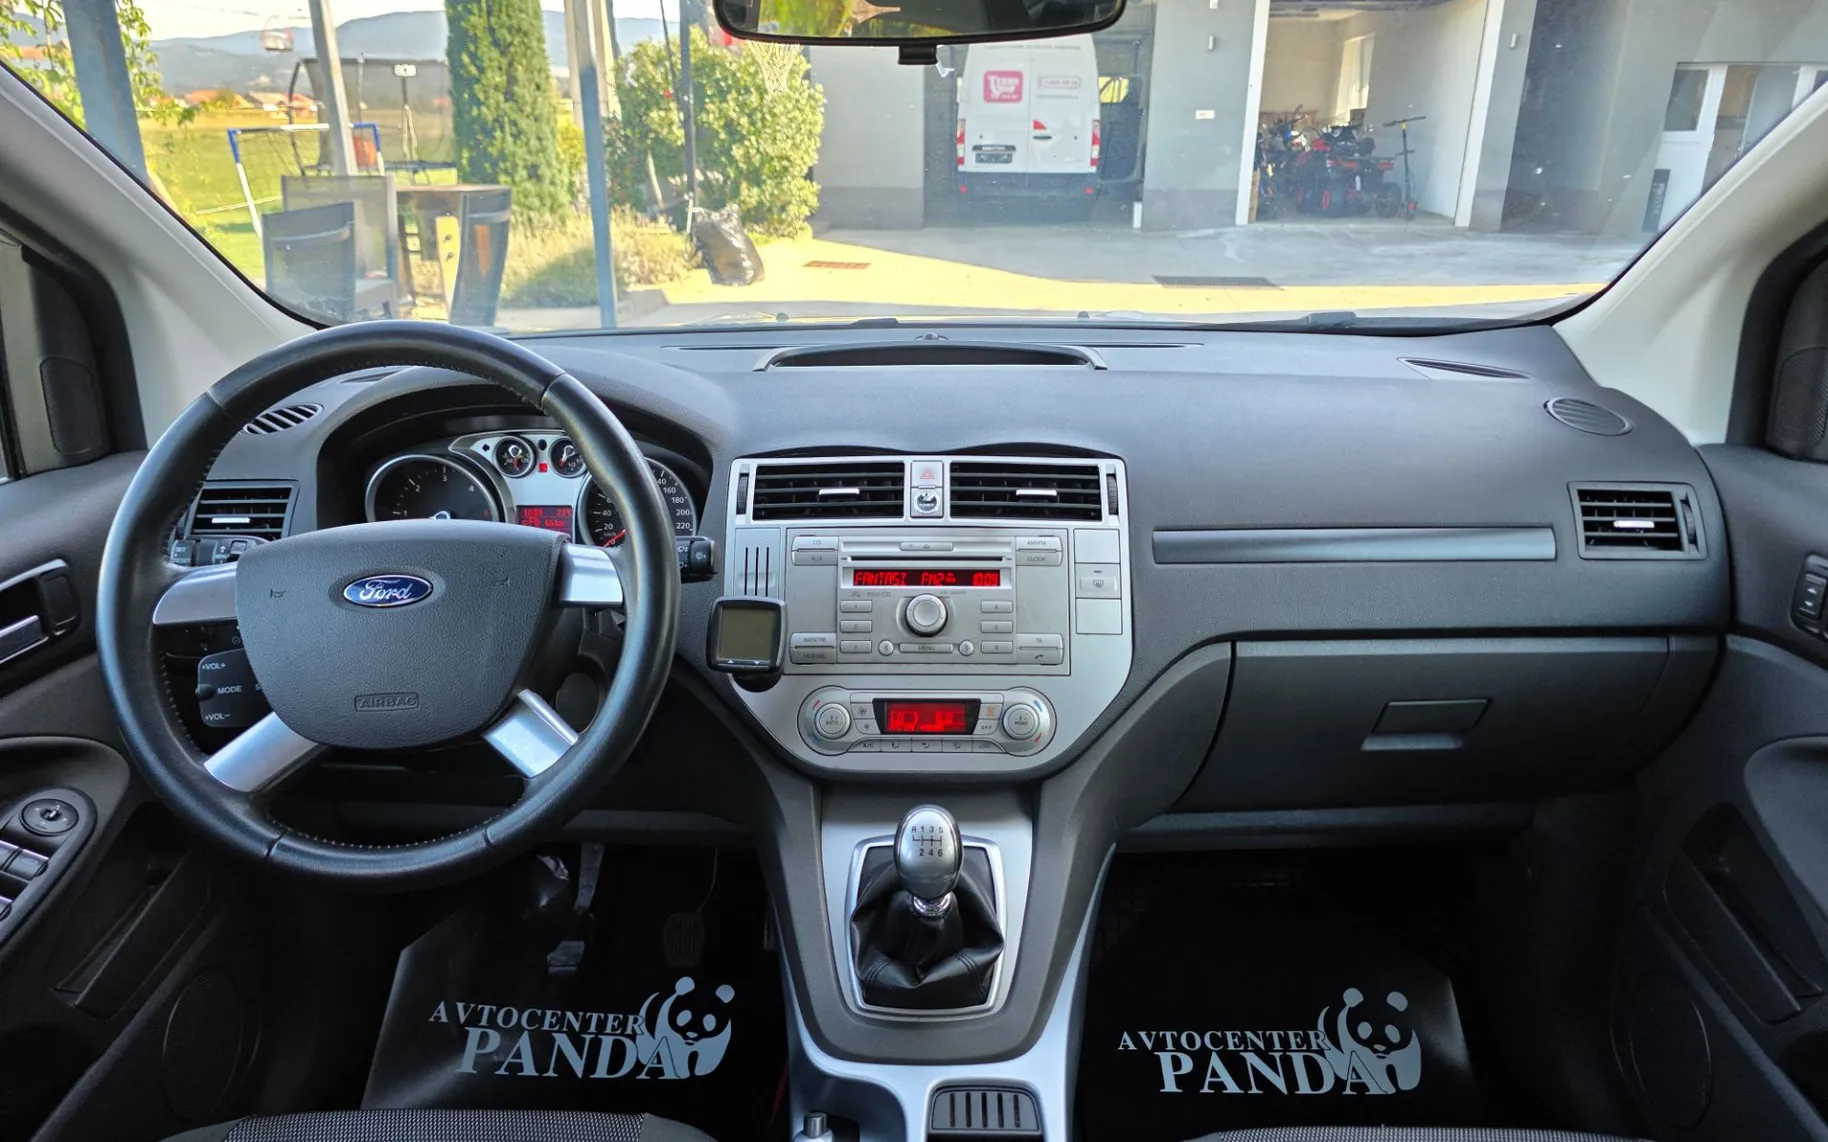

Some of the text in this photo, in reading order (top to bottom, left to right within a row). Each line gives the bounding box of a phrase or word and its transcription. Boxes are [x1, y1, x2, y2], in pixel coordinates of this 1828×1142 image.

[663, 486, 677, 494] 160
[671, 496, 685, 504] 180
[602, 509, 612, 517] 40
[676, 522, 691, 530] 220
[360, 579, 413, 600] Ford
[217, 685, 243, 695] MODE
[360, 696, 417, 709] AIRBAG
[918, 848, 943, 857] 2 4 6
[428, 1000, 646, 1036] AVTOCENTER
[1117, 1030, 1332, 1051] AVTOCENTER
[455, 1026, 684, 1080] PANDA
[1153, 1050, 1392, 1096] PANDA
